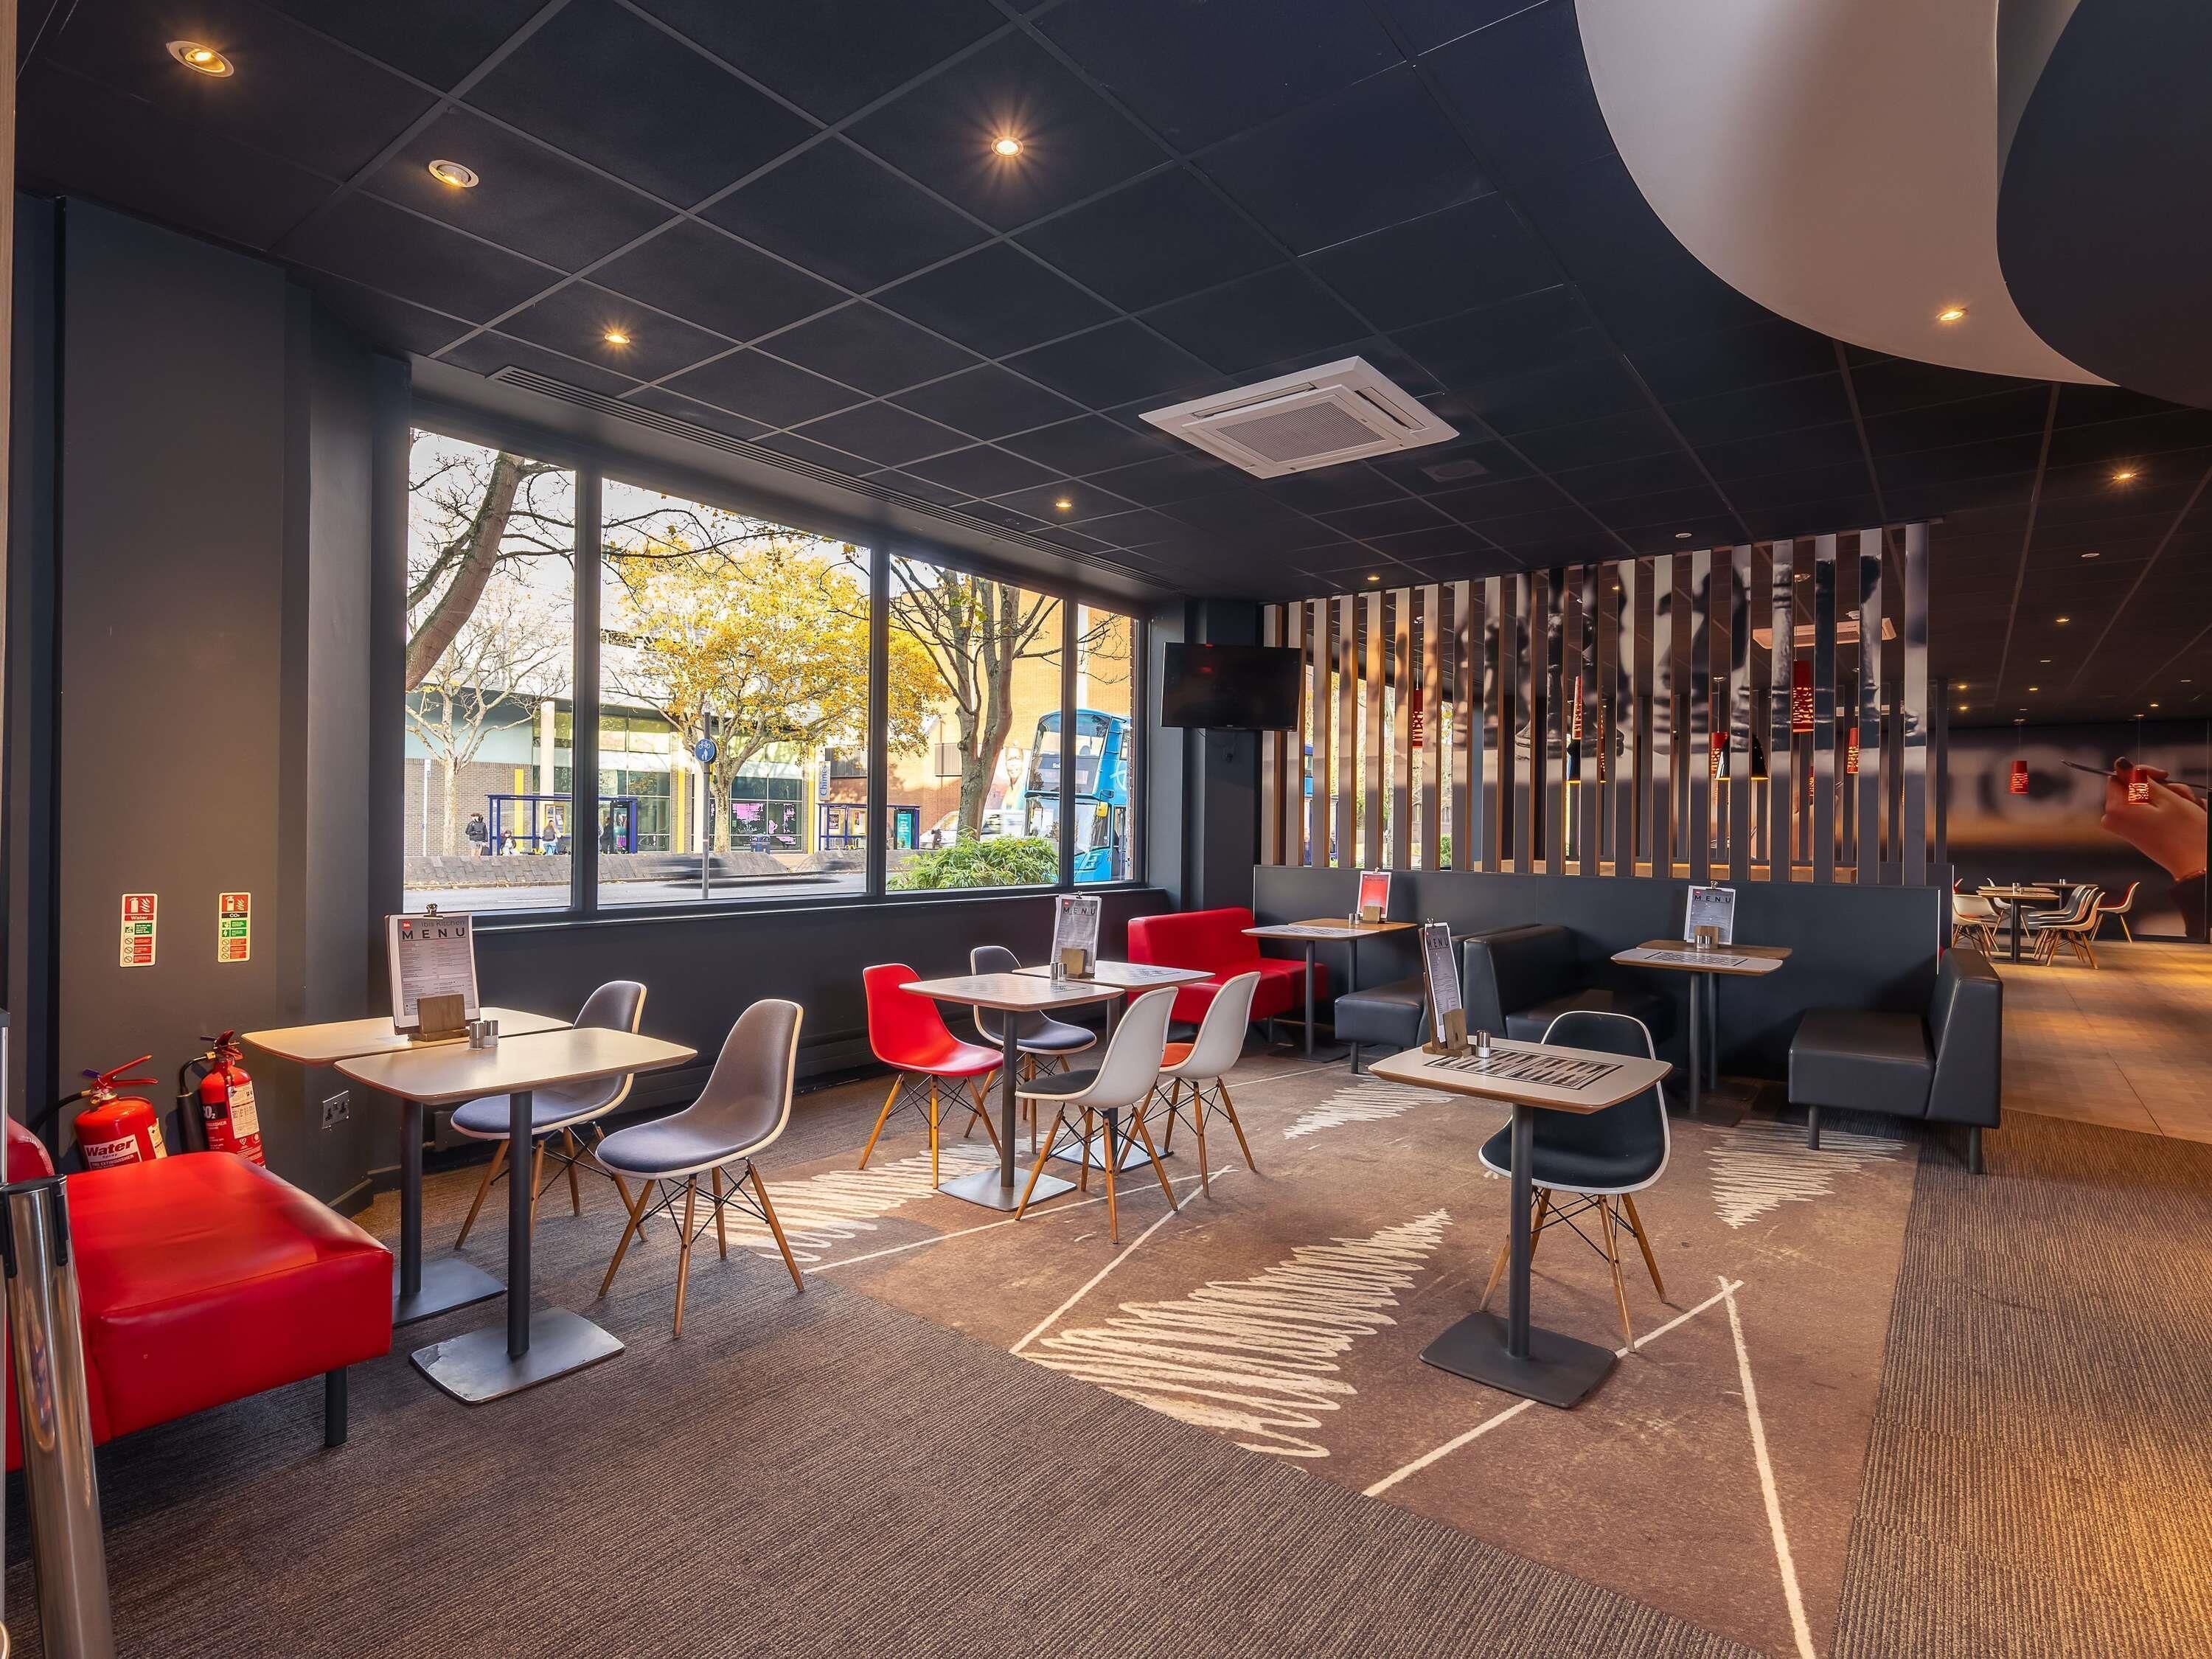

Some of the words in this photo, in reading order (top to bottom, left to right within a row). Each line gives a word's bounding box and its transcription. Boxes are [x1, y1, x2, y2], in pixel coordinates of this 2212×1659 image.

[820, 765, 828, 796] Chimes
[1062, 907, 1096, 915] MENU
[402, 927, 465, 940] MENU
[1427, 937, 1450, 948] MENU
[86, 1138, 134, 1157] Water
